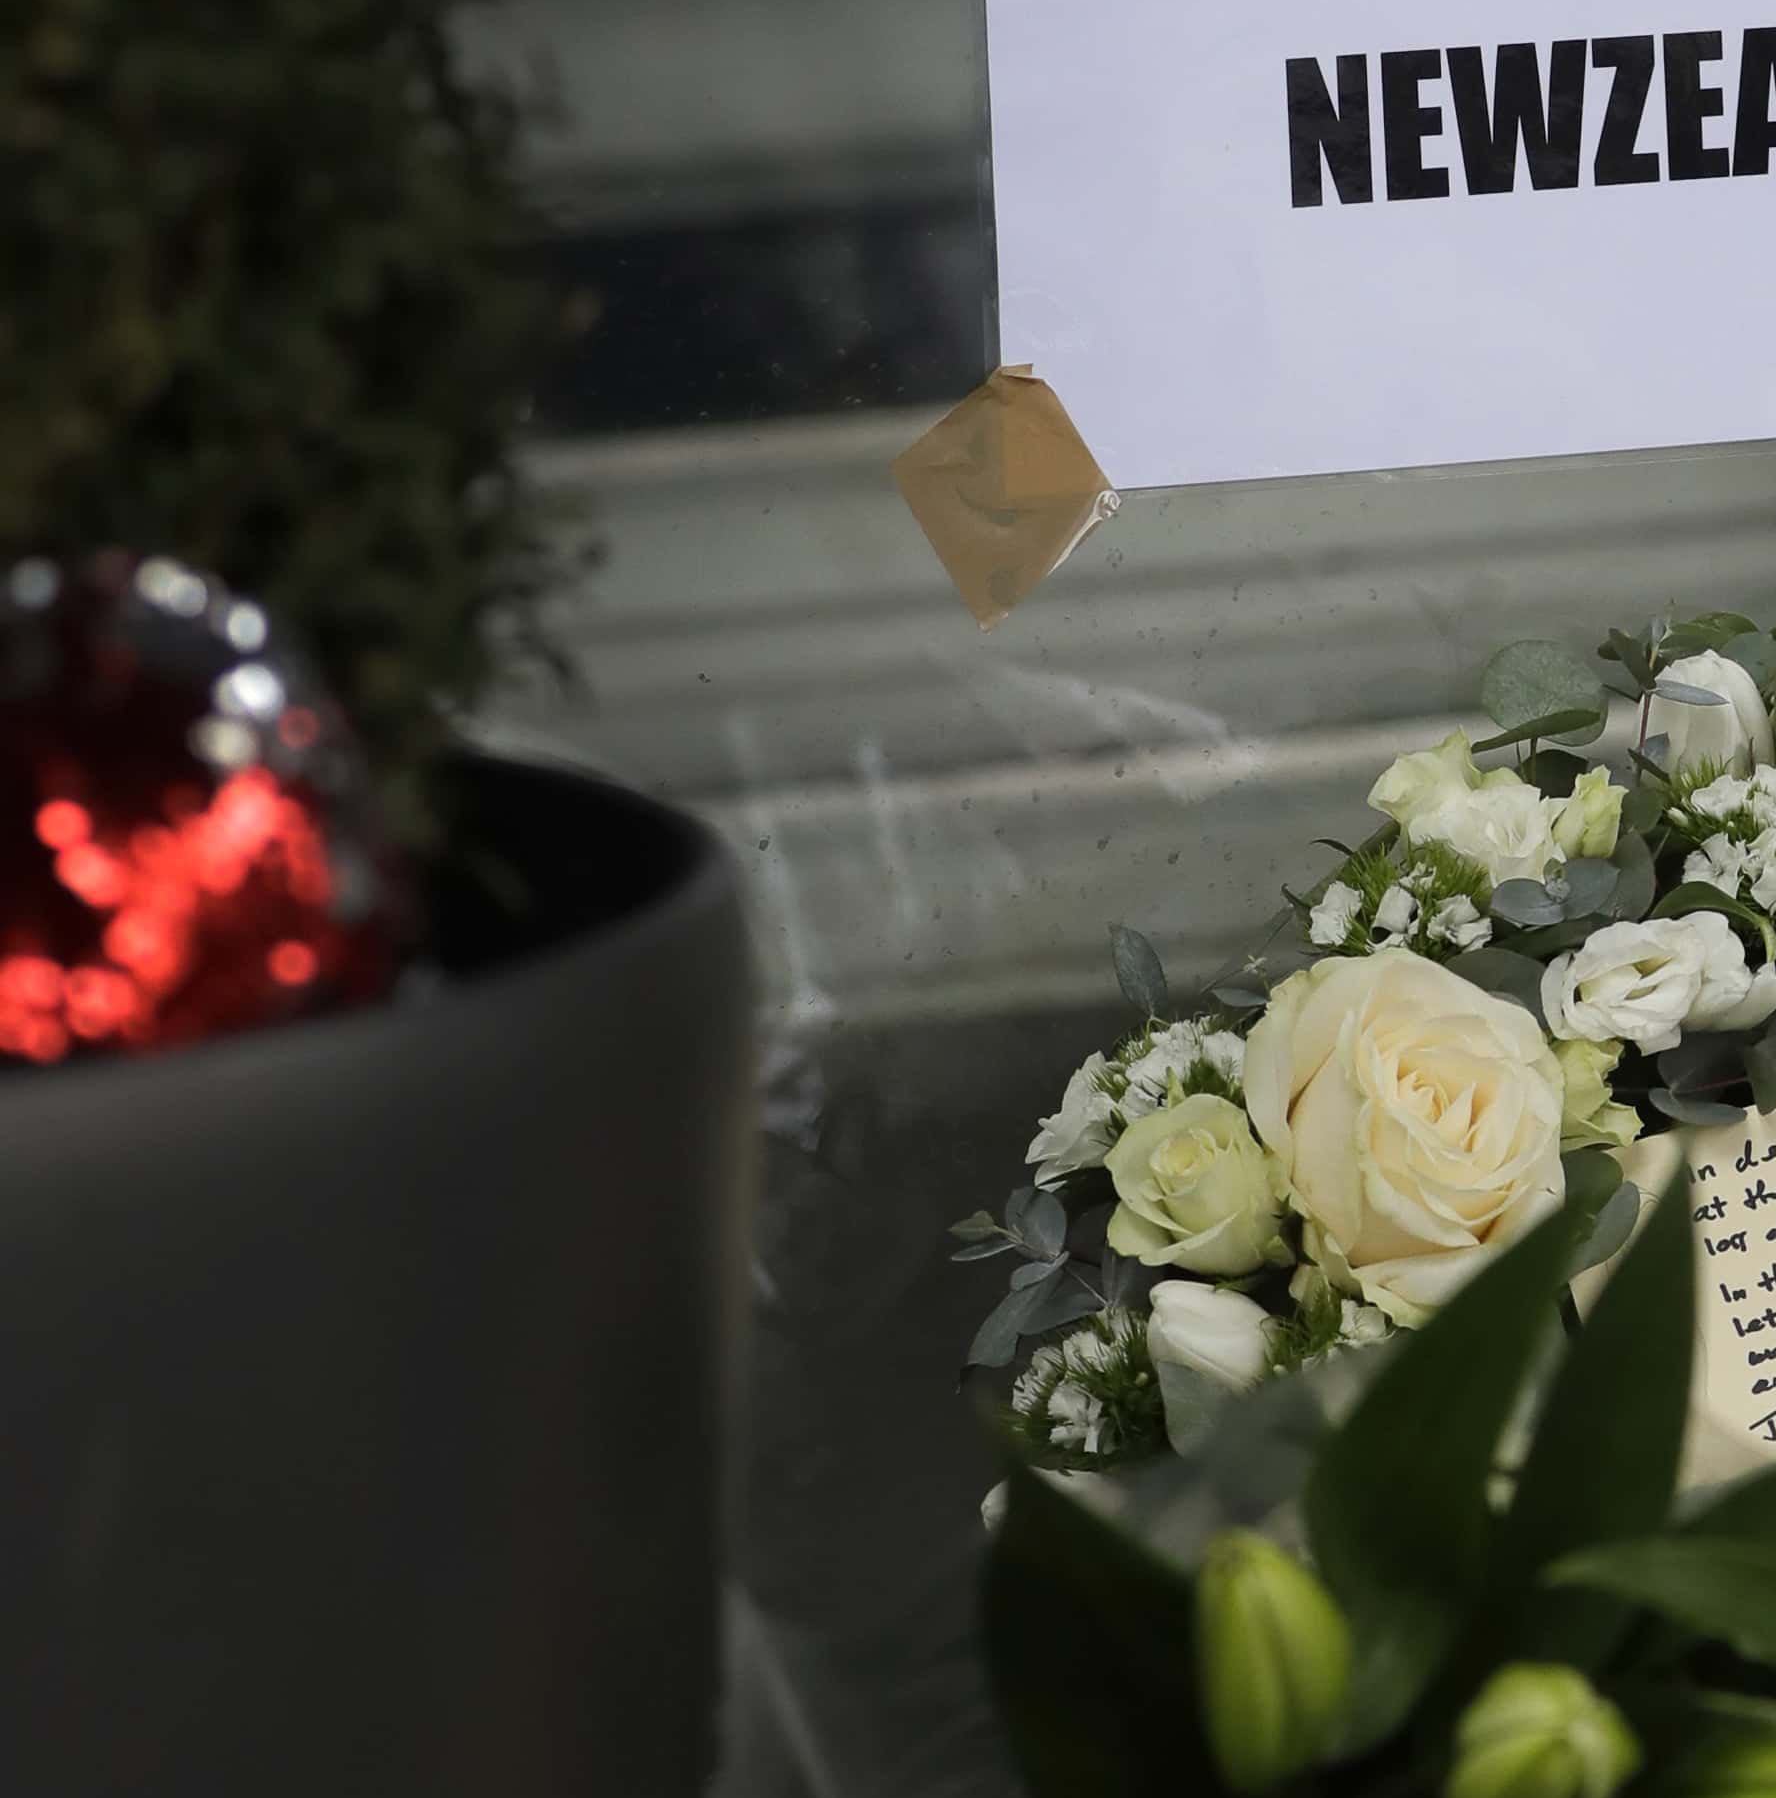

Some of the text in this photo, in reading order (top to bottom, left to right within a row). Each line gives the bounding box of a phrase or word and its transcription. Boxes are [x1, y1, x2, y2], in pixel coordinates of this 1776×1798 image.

[1693, 1196, 1728, 1223] at
[1704, 1231, 1747, 1256] loss
[1719, 1283, 1747, 1303] In
